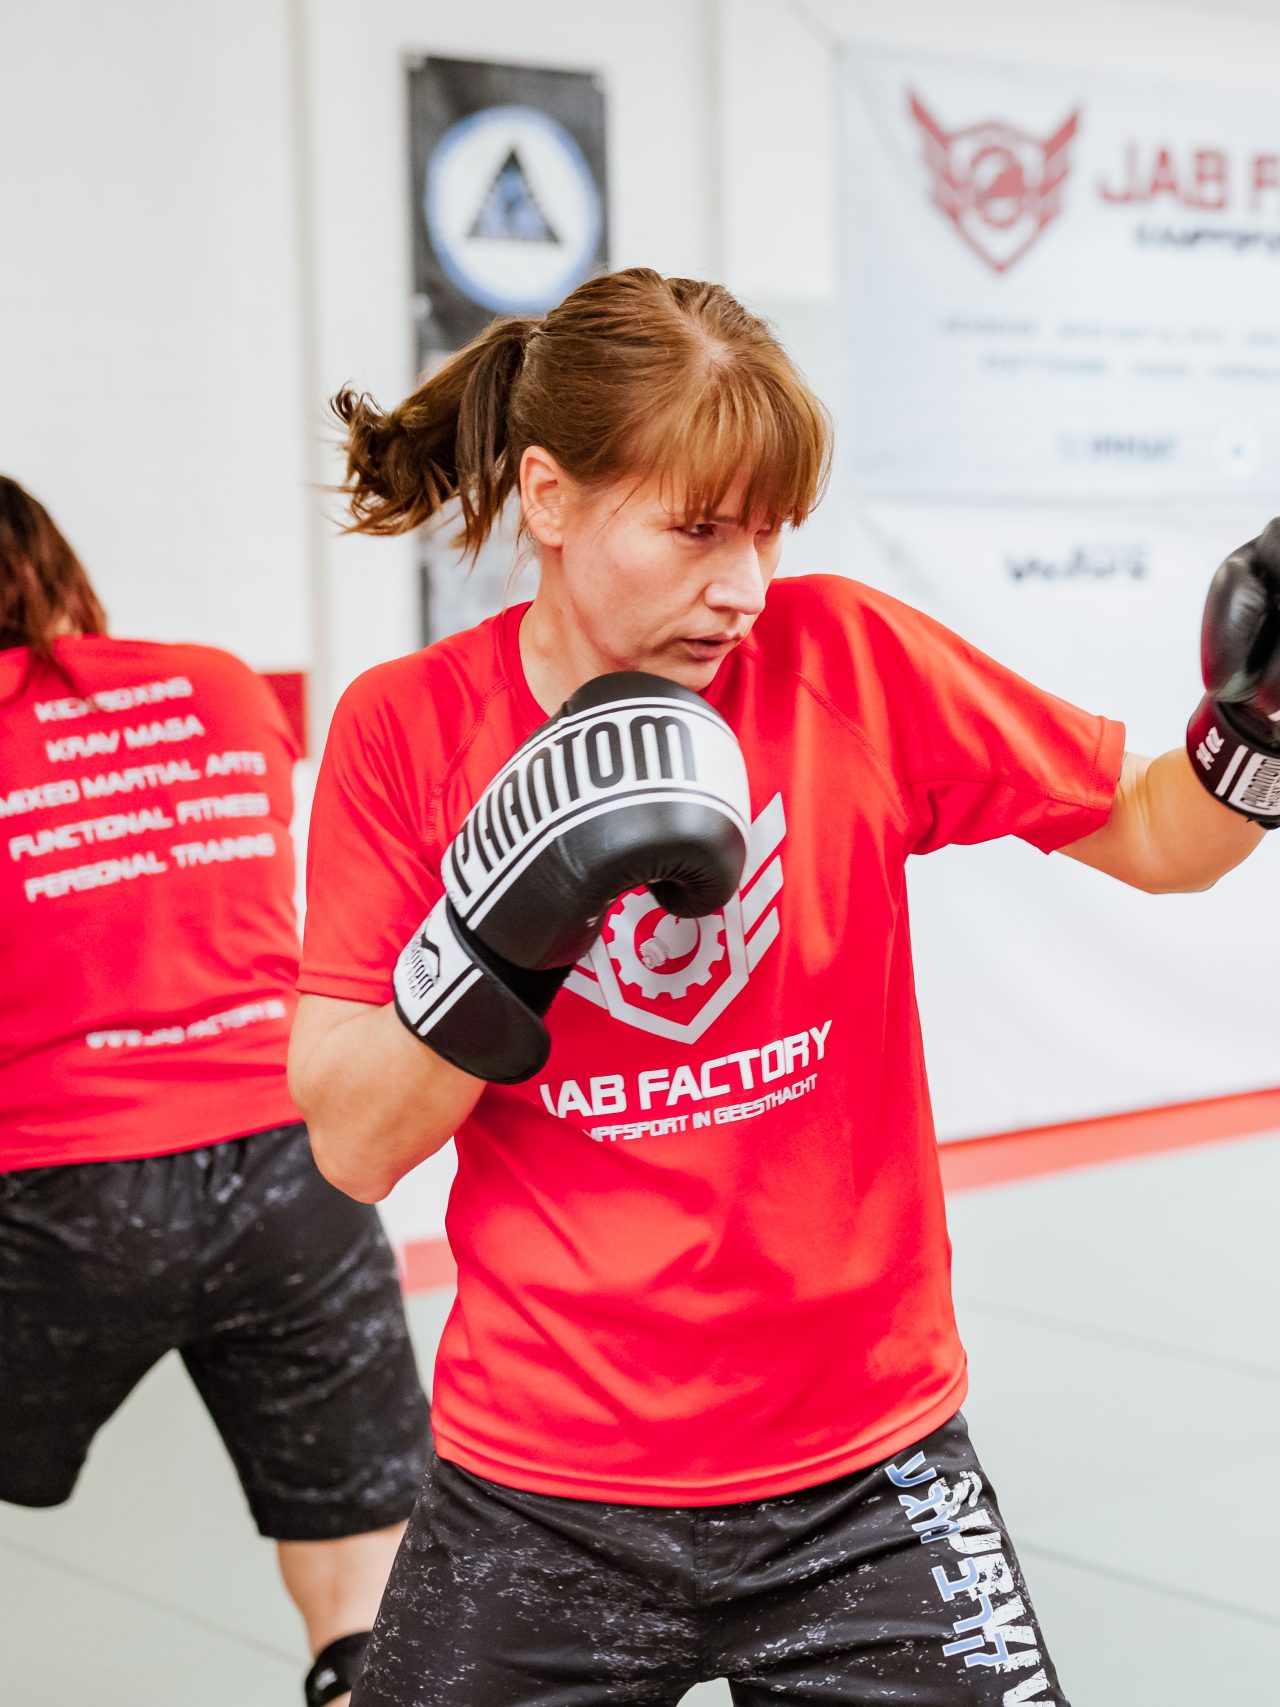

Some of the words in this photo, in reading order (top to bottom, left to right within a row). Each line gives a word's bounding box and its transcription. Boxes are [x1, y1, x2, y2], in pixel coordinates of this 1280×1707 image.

[1096, 141, 1230, 212] JAB
[46, 729, 120, 763] KRAV
[81, 759, 200, 799] MARTIAL
[205, 750, 267, 777] ARTS
[9, 806, 173, 861] FUNCTIONAL
[451, 715, 697, 898] PHANTOM
[638, 1020, 832, 1110] FACTORY
[582, 1113, 689, 1143] PFSPORT
[692, 1110, 712, 1129] IN
[714, 1073, 818, 1125] GEESTHACHT
